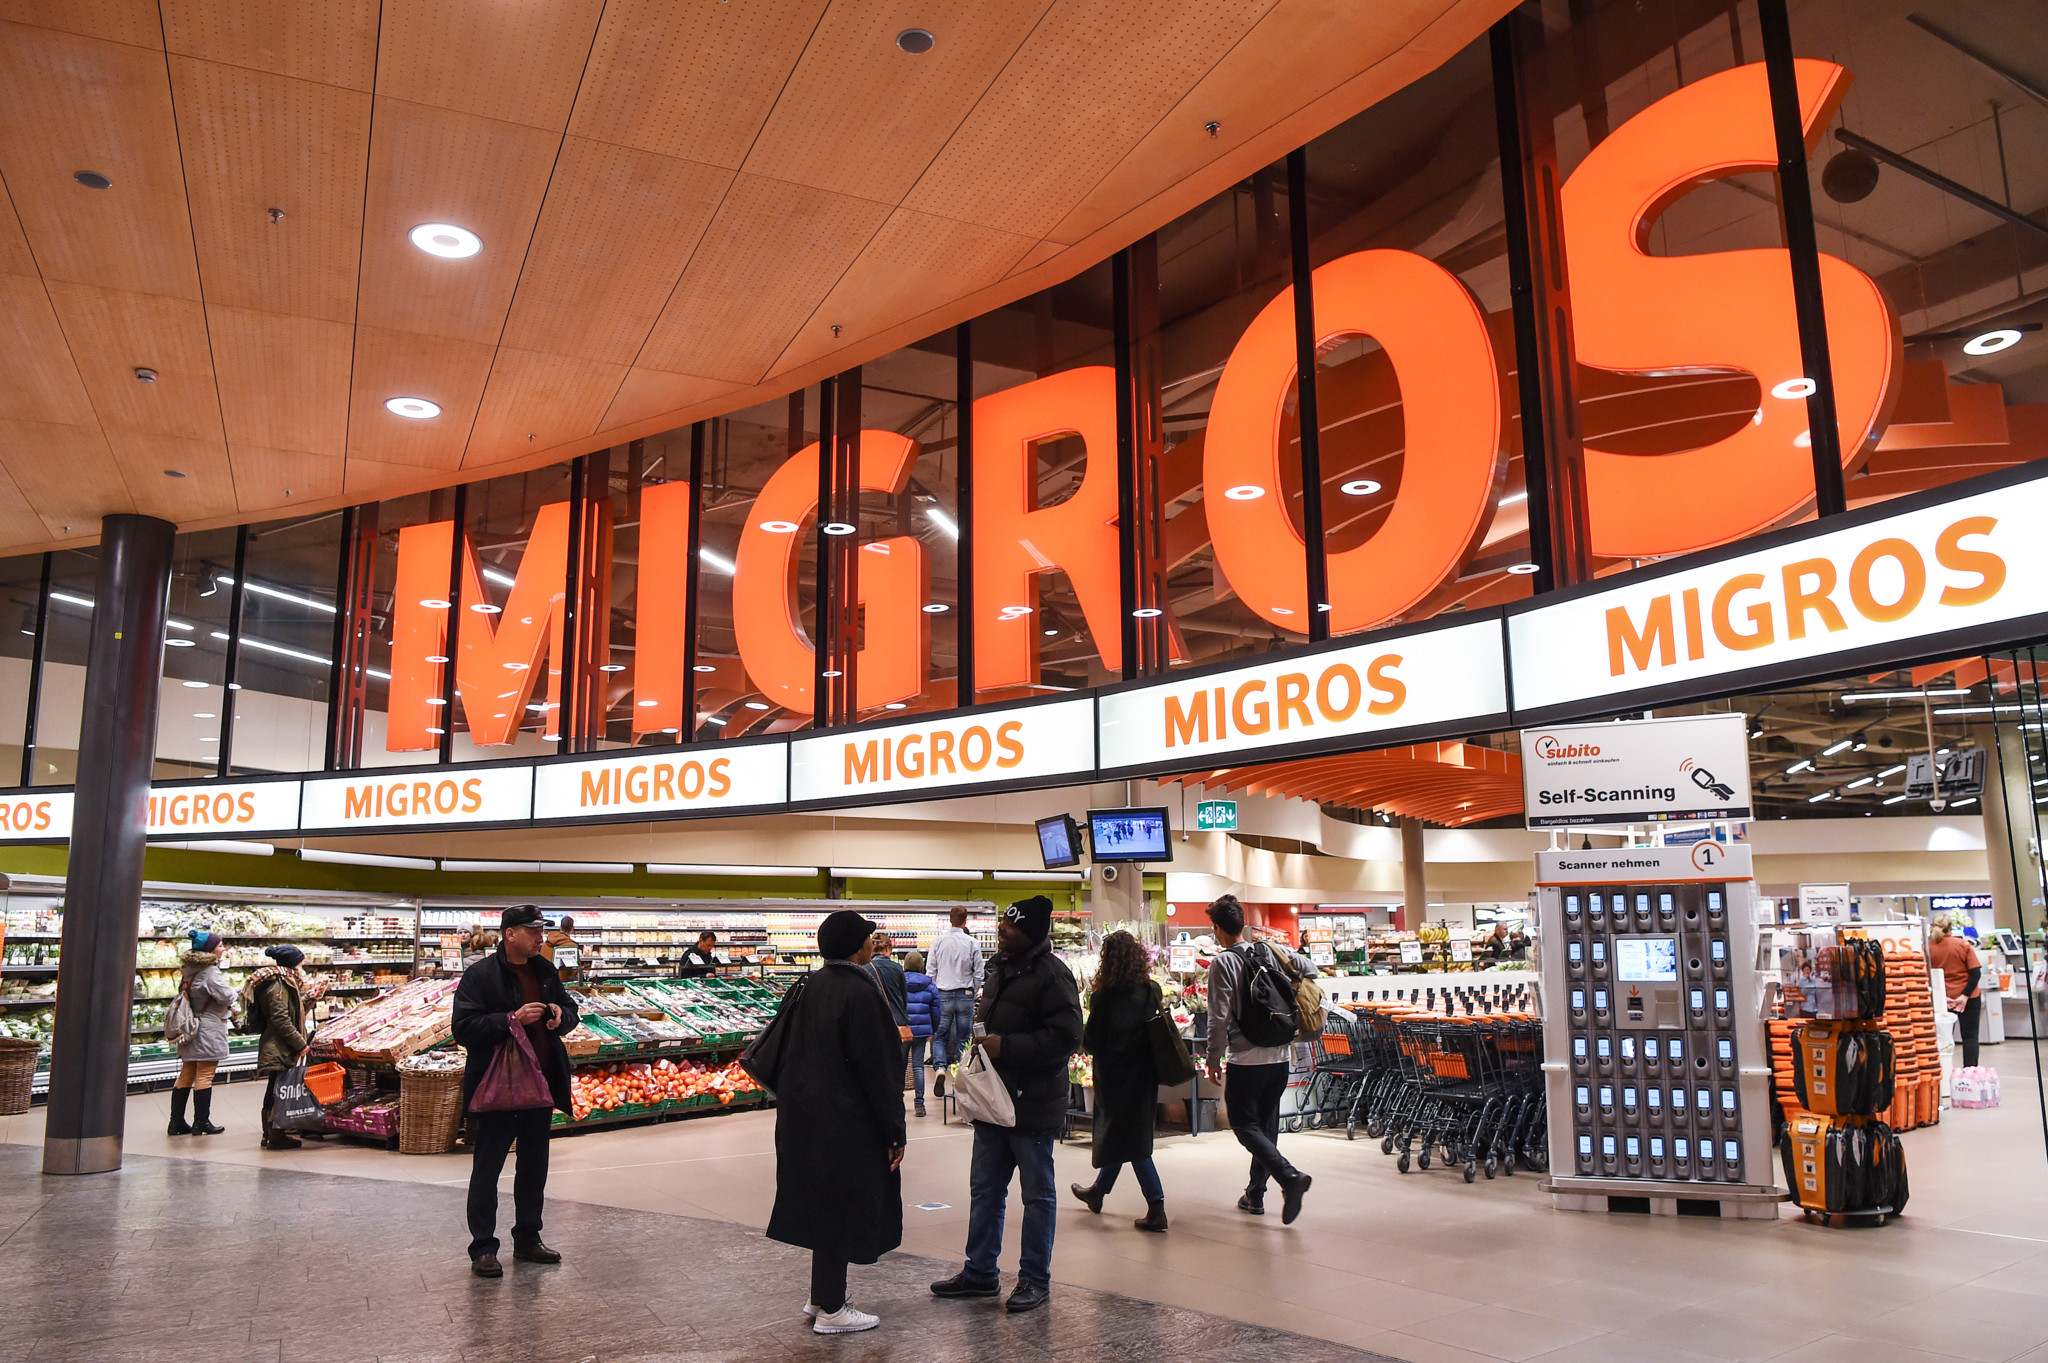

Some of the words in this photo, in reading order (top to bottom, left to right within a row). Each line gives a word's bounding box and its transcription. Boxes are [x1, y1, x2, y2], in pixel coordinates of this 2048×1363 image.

[386, 58, 1899, 752] MIGROS
[1605, 516, 2007, 677] MIGROS
[1164, 653, 1407, 748] MIGROS
[844, 720, 1025, 785] MIGROS
[1546, 743, 1601, 759] subito
[344, 778, 482, 819] MIGROS
[580, 758, 731, 807] MIGROS
[1539, 785, 1676, 805] Self-Scanning
[1540, 818, 1569, 826] Bargeldlos
[1558, 859, 1608, 870] Scanner
[1611, 858, 1660, 869] nehmen
[1702, 847, 1715, 865] 1
